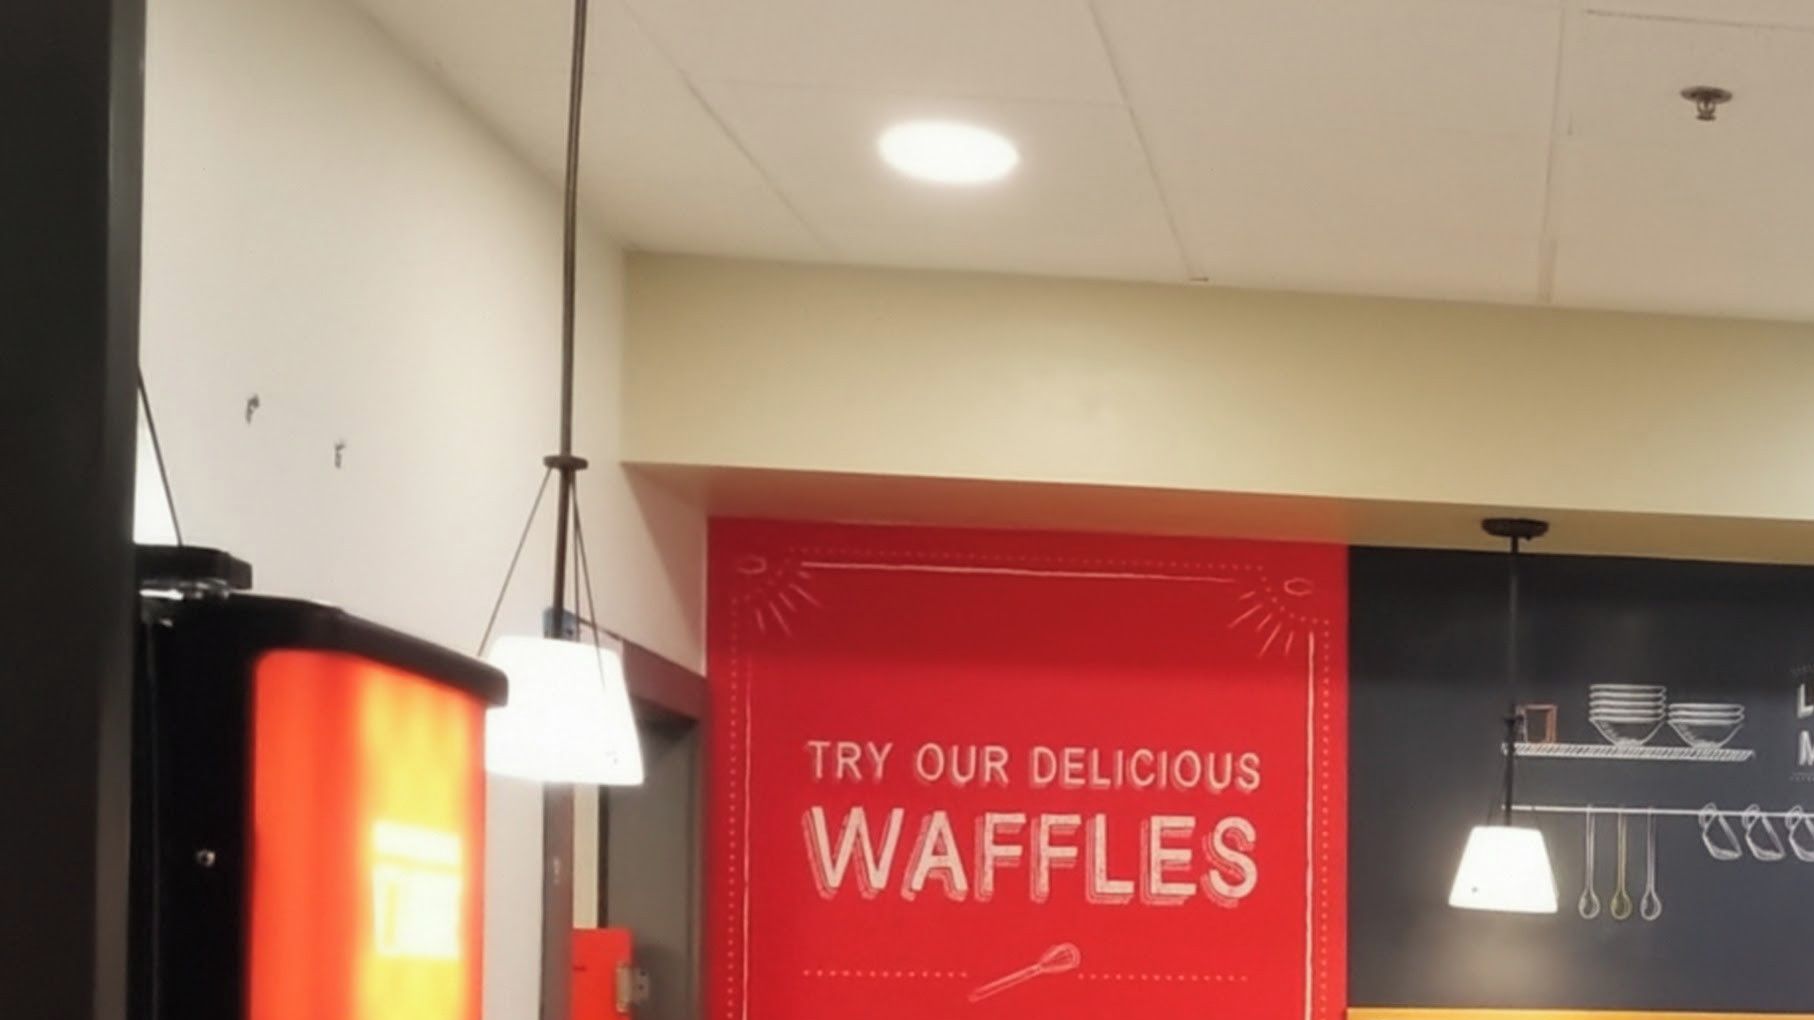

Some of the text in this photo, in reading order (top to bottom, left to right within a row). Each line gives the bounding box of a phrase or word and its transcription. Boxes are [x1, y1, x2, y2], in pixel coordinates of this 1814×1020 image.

[807, 740, 1261, 792] TRY OUR DELICIOUS
[802, 806, 1258, 908] WAFFLES
